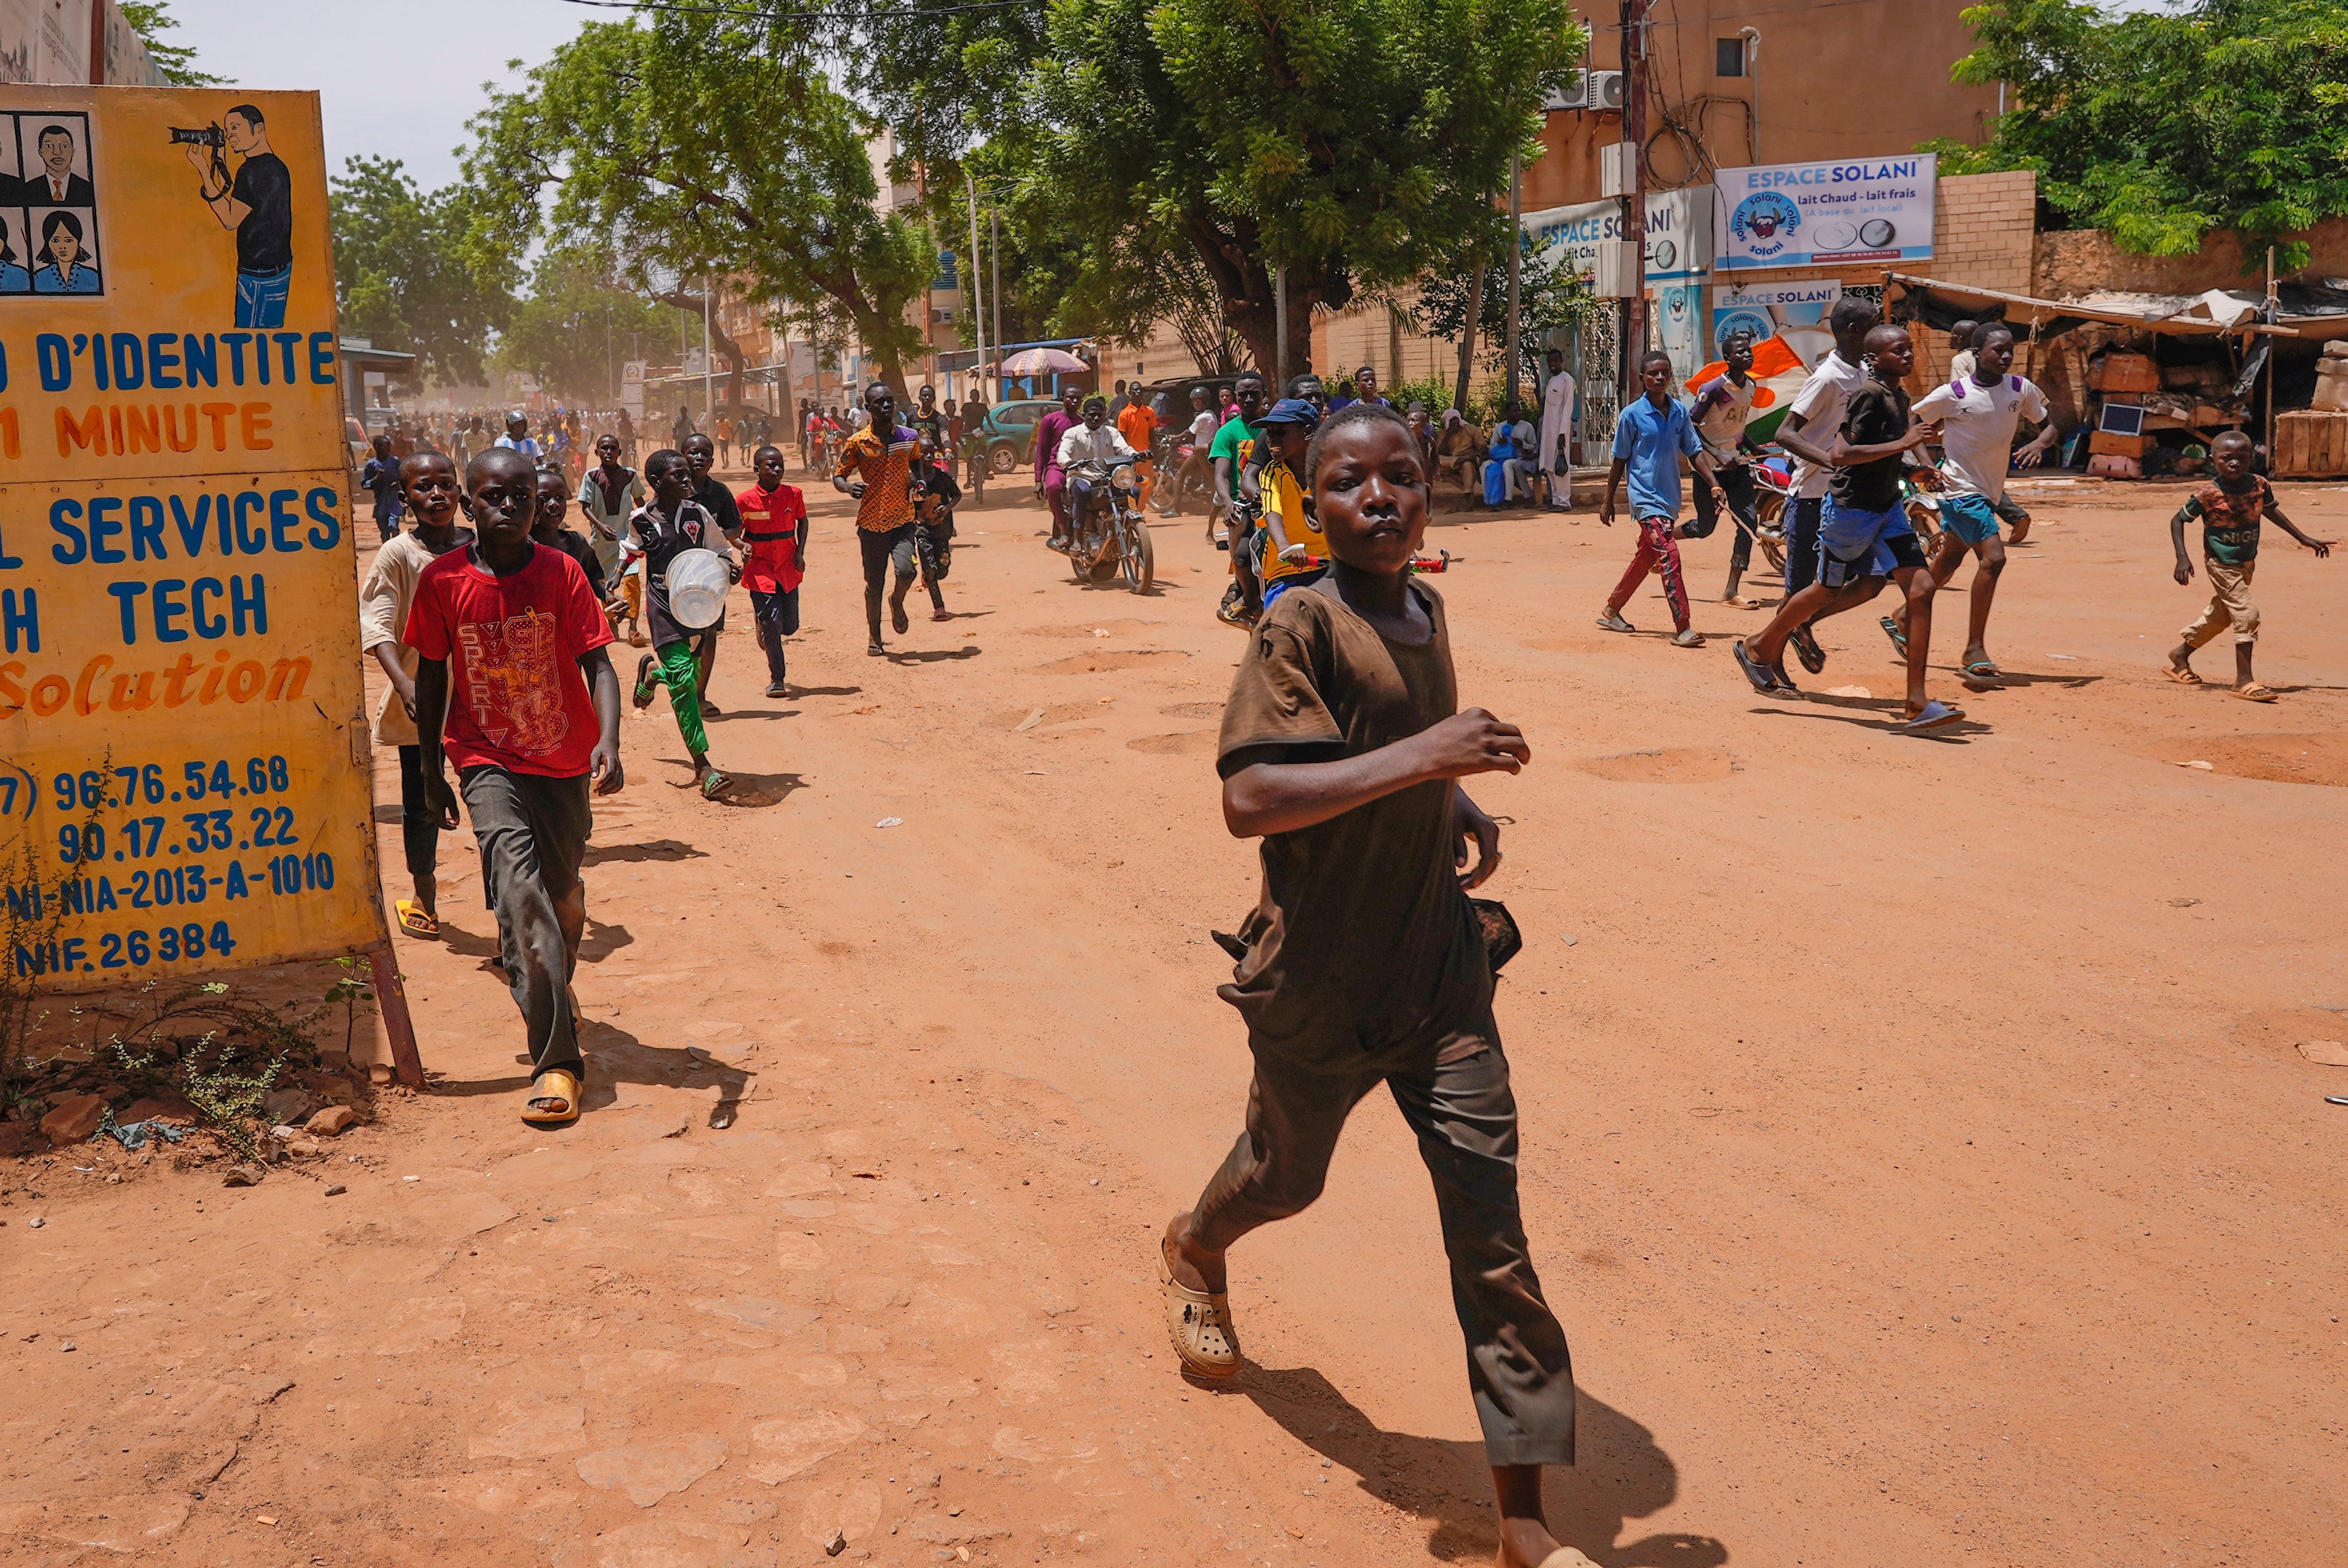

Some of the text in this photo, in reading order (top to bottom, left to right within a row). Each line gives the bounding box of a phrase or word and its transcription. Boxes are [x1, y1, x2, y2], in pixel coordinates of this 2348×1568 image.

[1747, 161, 1916, 188] ESPACE SOLANI
[1749, 193, 1783, 206] solani
[1798, 194, 1817, 205] lait
[1820, 191, 1856, 203] Chaud
[1867, 190, 1886, 200] lait
[1889, 188, 1916, 199] frais
[1542, 219, 1601, 245] ESPACE
[1734, 210, 1747, 242] solani
[1784, 205, 1797, 237] solani
[1749, 240, 1784, 255] solani
[1722, 290, 1832, 306] ESPACE SOLANI
[1730, 314, 1755, 324] solani
[37, 332, 337, 392] D'IDENTITE
[54, 401, 274, 459] MINUTE
[50, 487, 340, 565] SERVICES
[3, 574, 268, 653] H TECH
[0, 648, 313, 720] Solution
[54, 755, 289, 811] 96.76.54.68
[59, 806, 299, 863] 90.17.33.22
